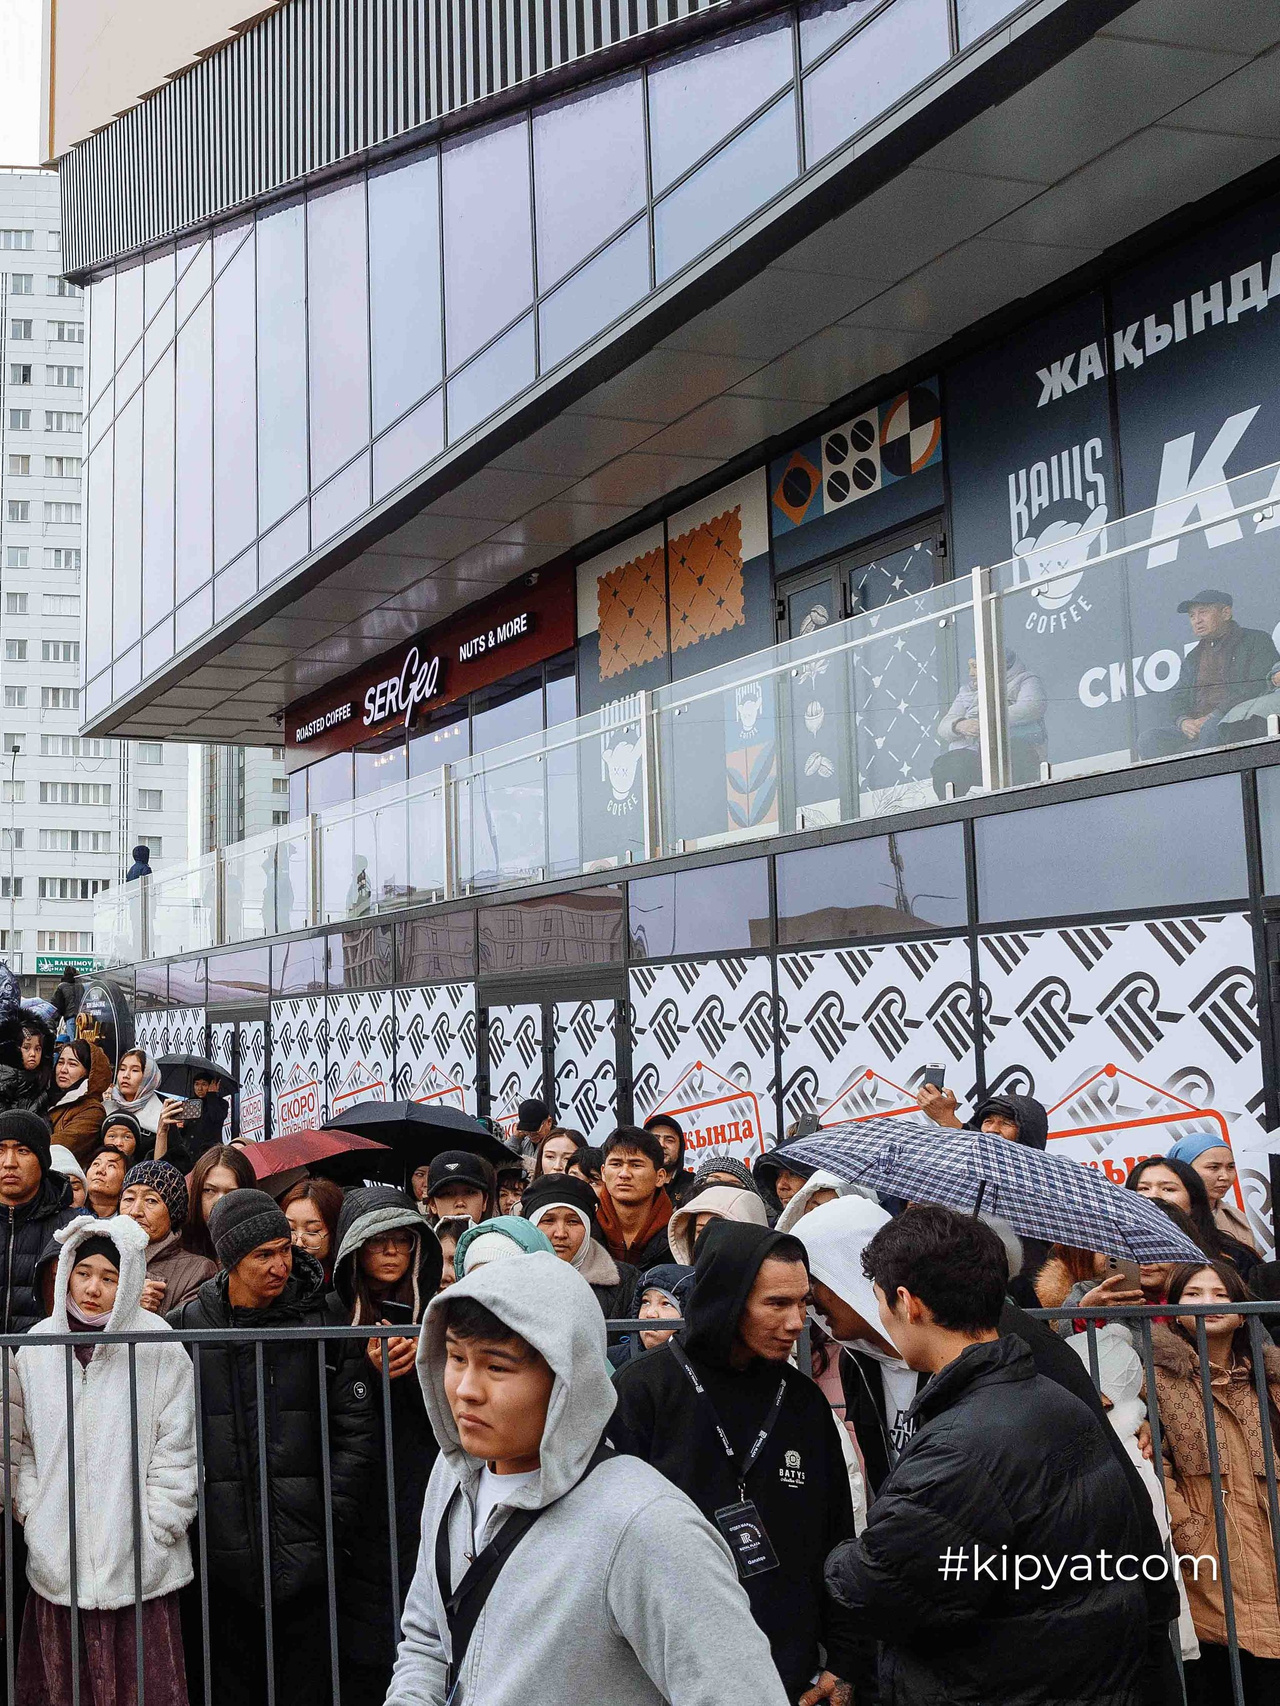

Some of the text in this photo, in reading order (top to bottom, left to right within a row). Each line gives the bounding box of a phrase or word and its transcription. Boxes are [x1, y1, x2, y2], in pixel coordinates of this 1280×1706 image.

[1036, 251, 1280, 408] ЖАҚЫНД
[1025, 595, 1092, 634] COFFEE
[459, 613, 527, 662] NUTS & MORE
[1078, 640, 1201, 708] СКО
[295, 703, 351, 743] ROASTED COFFEE
[607, 793, 638, 816] COFFEE
[281, 1092, 314, 1122] СКОРО
[683, 1119, 754, 1151] қында
[779, 1468, 805, 1480] BATYS
